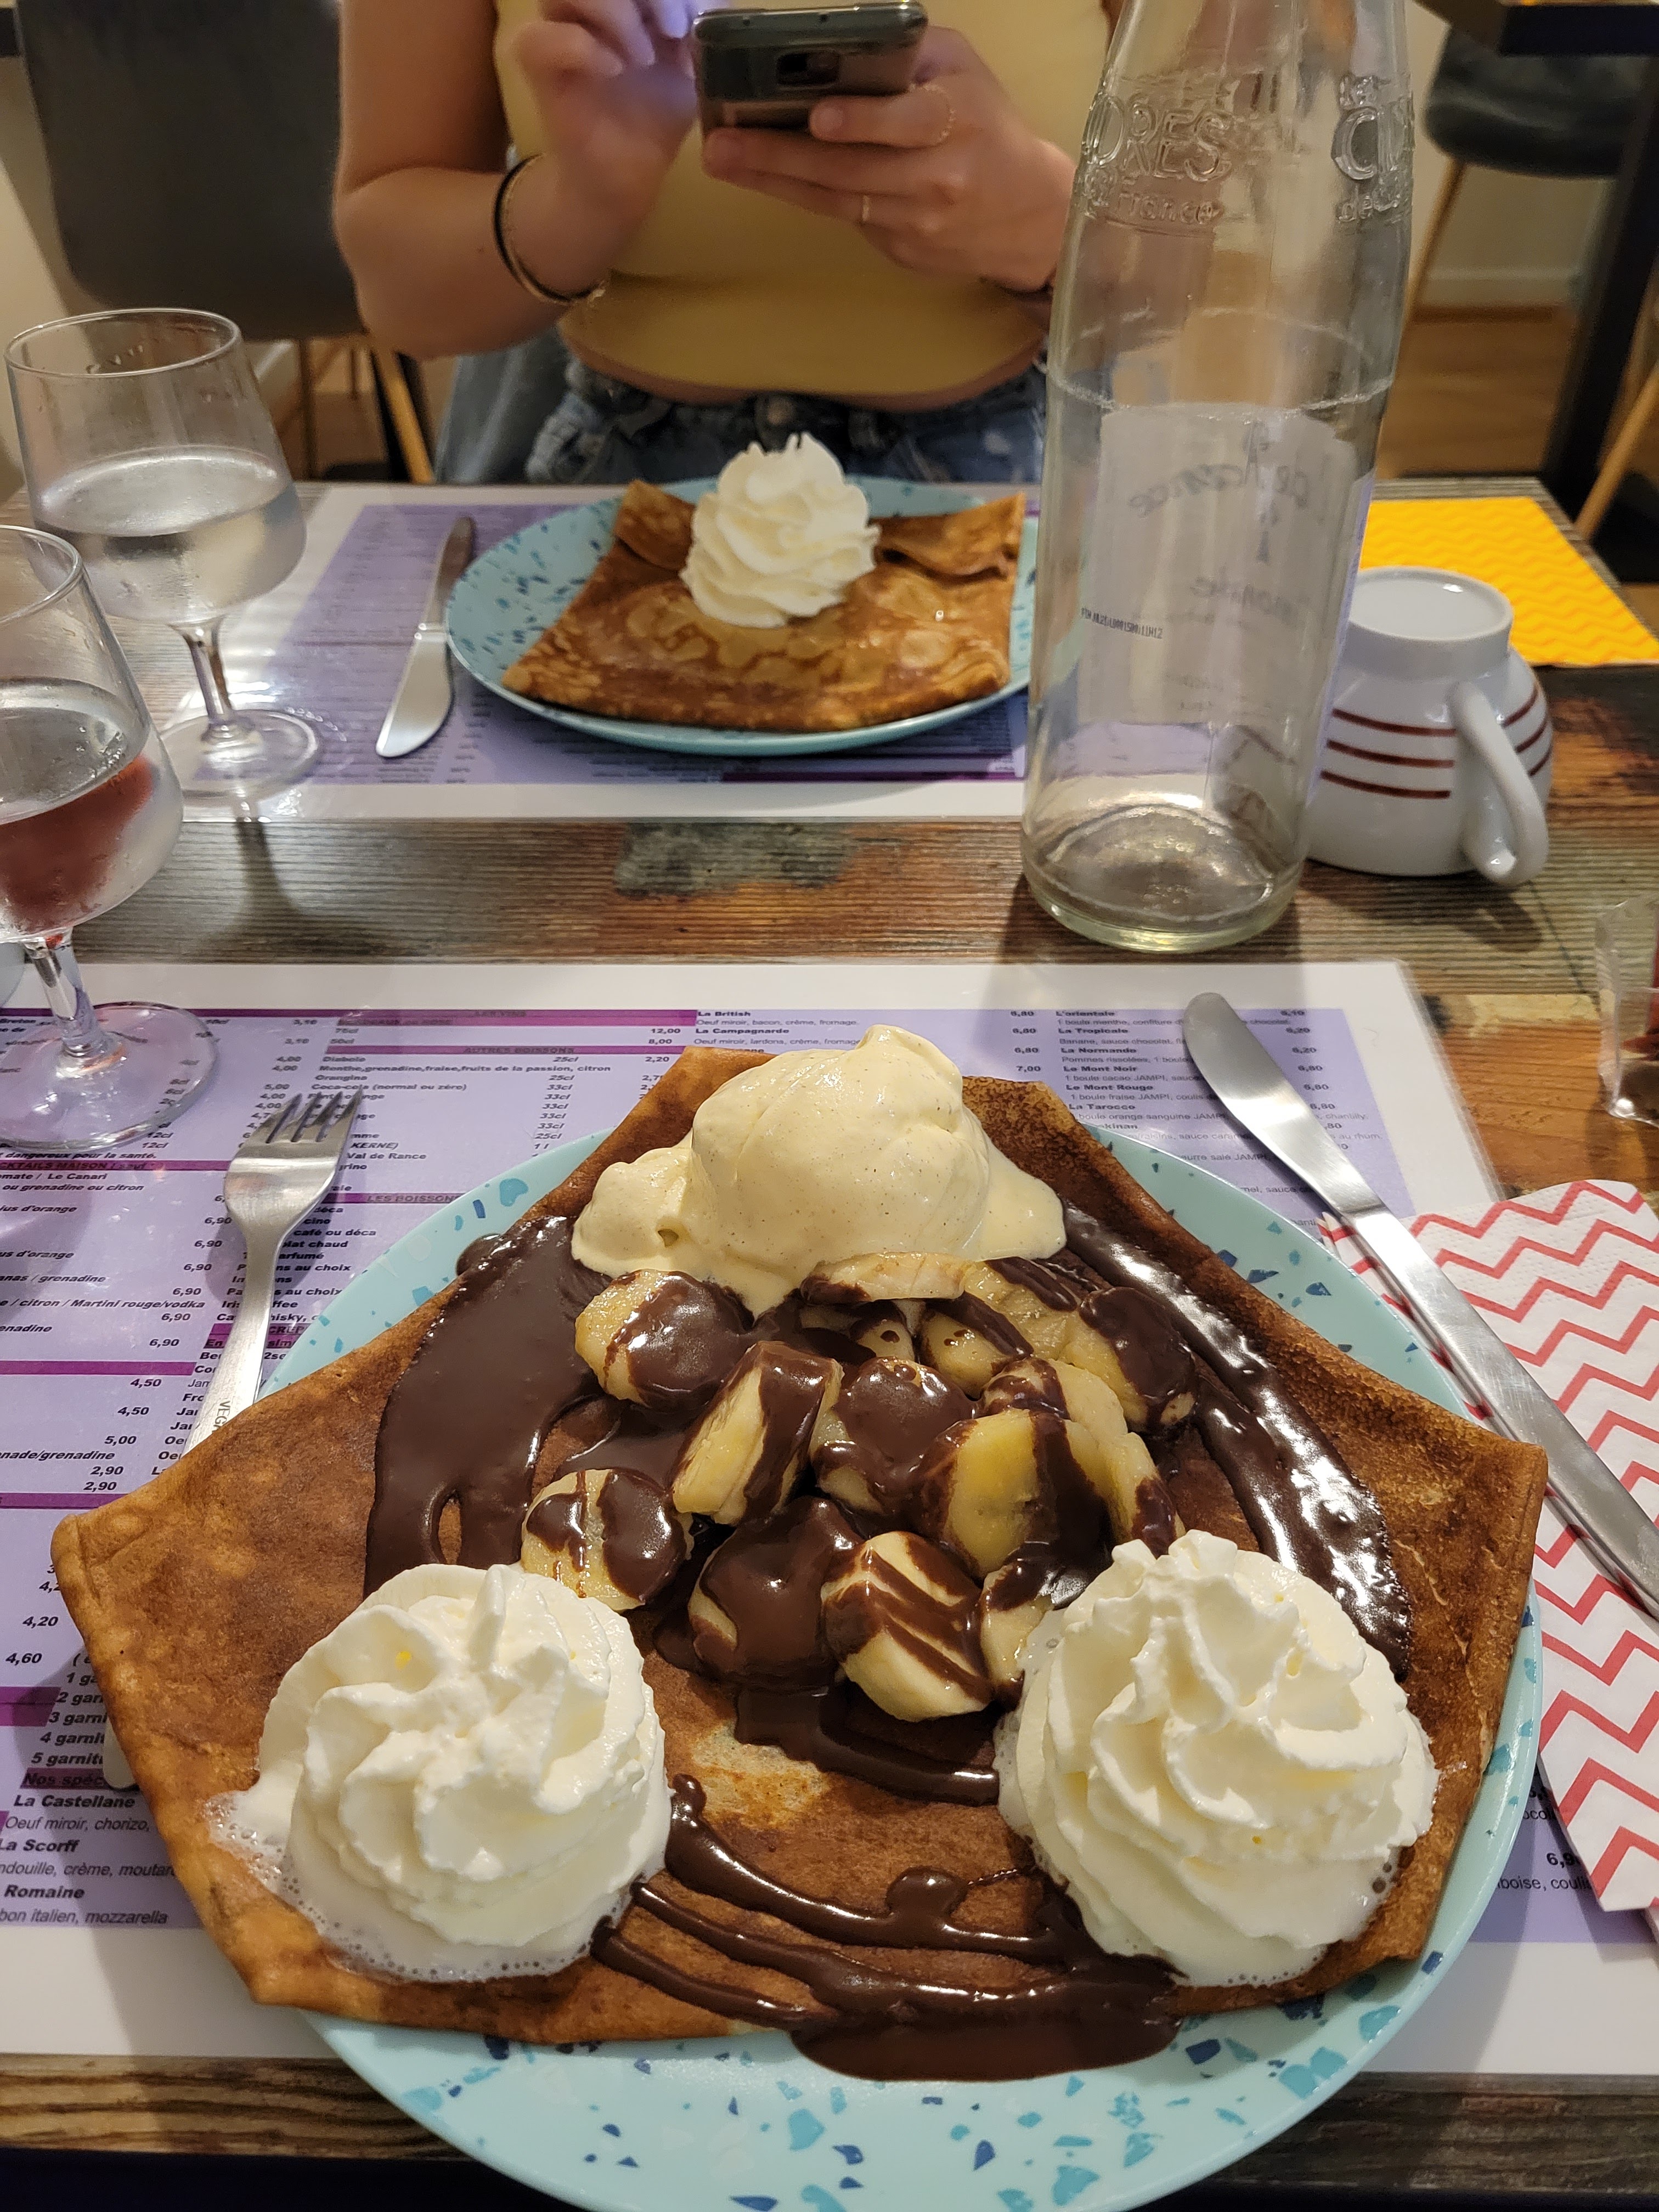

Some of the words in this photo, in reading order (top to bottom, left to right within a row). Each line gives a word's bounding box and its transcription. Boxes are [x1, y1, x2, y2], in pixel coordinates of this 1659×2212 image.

[21, 1205, 77, 1214] d'orange
[16, 1251, 75, 1259] d'orange
[121, 1300, 205, 1309] rouge/vodka
[161, 1313, 190, 1322] 6,90
[149, 1339, 179, 1347] 6,90
[130, 1378, 162, 1388] 4,50
[117, 1407, 149, 1417] 4,50
[104, 1436, 137, 1446] 5,00
[0, 1450, 115, 1461] nade/grenadine
[90, 1466, 124, 1476] 2,90
[83, 1482, 117, 1492] 2,90
[22, 1616, 59, 1628] 4,20
[5, 1653, 42, 1666] 4,60
[55, 1692, 69, 1703] 2
[48, 1712, 60, 1723] 3
[40, 1731, 52, 1743] 4
[31, 1752, 44, 1764] 5
[14, 1795, 35, 1807] La
[42, 1795, 136, 1808] Castellane
[5, 1816, 43, 1830] Oeuf
[44, 1816, 89, 1831] miroir,
[94, 1818, 150, 1832] chorizo,
[23, 1839, 80, 1852] Scorff
[63, 1862, 112, 1877] crème,
[4, 1884, 84, 1899] Romaine
[30, 1909, 79, 1925] italien,
[84, 1910, 168, 1924] mozzarella
